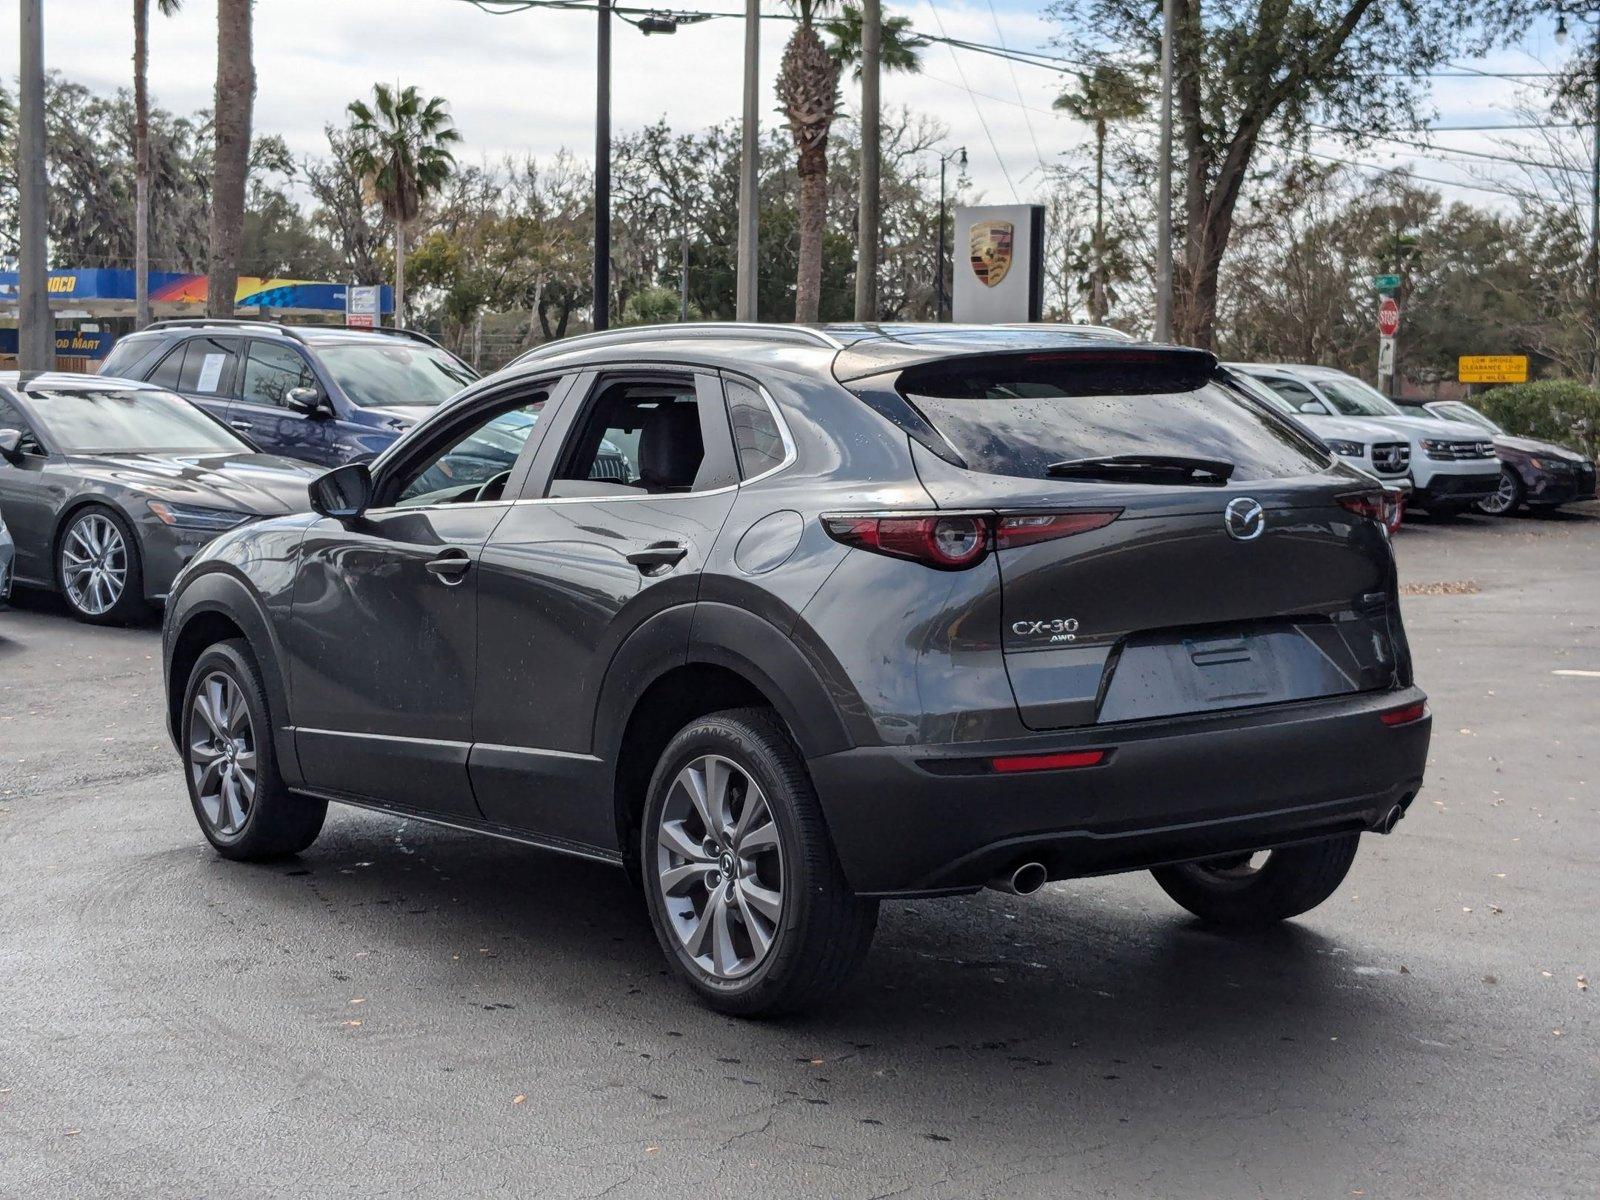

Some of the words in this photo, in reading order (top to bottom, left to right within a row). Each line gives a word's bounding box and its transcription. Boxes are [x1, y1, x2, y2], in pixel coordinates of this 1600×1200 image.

[1380, 310, 1397, 325] STOP
[56, 338, 70, 349] OD
[72, 337, 100, 350] MART
[1012, 618, 1079, 635] CX-30
[1050, 634, 1075, 642] AWD
